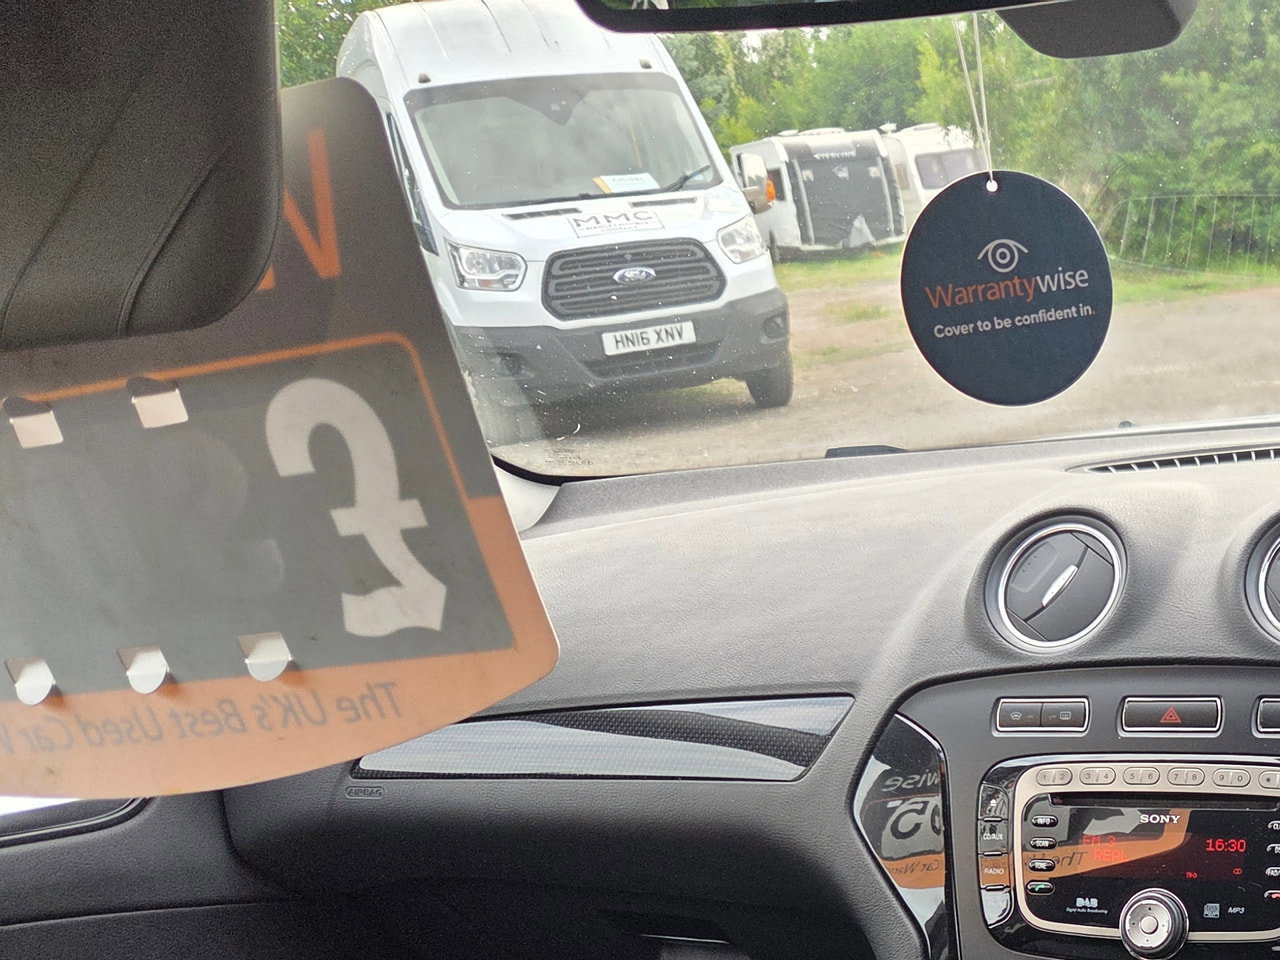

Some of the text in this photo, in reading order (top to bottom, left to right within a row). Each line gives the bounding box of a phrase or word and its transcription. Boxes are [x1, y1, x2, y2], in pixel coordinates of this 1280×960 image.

[572, 210, 653, 227] MMC
[925, 267, 1089, 309] Warrantywise
[933, 323, 974, 339] Cover
[976, 318, 991, 333] to
[994, 316, 1013, 330] be
[1015, 306, 1078, 327] confident
[613, 324, 684, 350] HN16 XNV
[347, 788, 382, 797] AIRBAG
[1139, 814, 1181, 824] SONY
[1081, 835, 1101, 848] FM
[1205, 838, 1247, 852] 16:30
[984, 867, 1004, 875] RADIO
[1076, 897, 1098, 908] DAB
[1227, 906, 1245, 914] MP3
